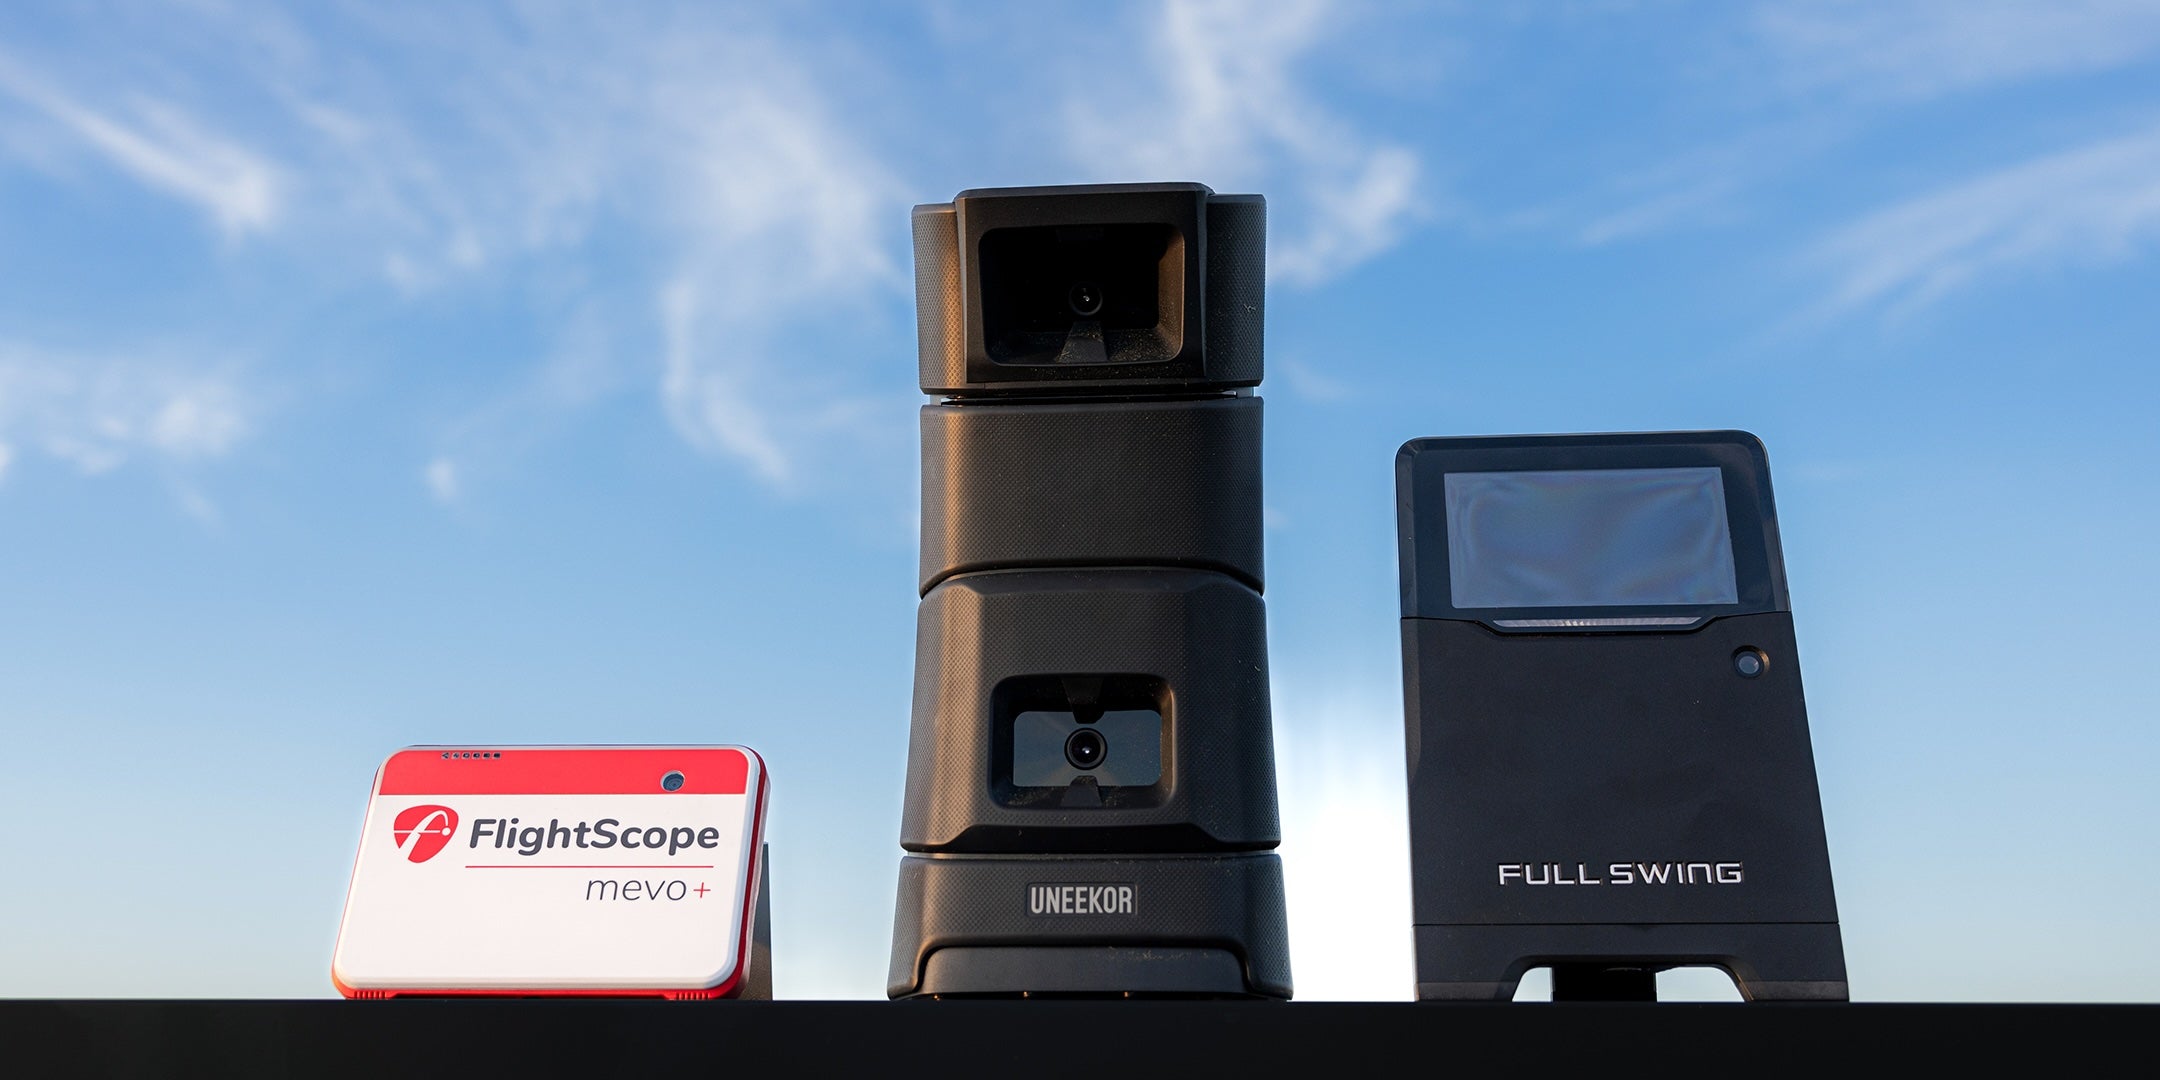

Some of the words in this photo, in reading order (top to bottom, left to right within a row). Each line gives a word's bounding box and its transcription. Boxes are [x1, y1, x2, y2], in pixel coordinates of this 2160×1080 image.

[469, 818, 720, 856] FlightScope
[1498, 862, 1601, 886] FULL
[1609, 861, 1744, 885] SWING
[1030, 886, 1133, 914] UNEEKOR
